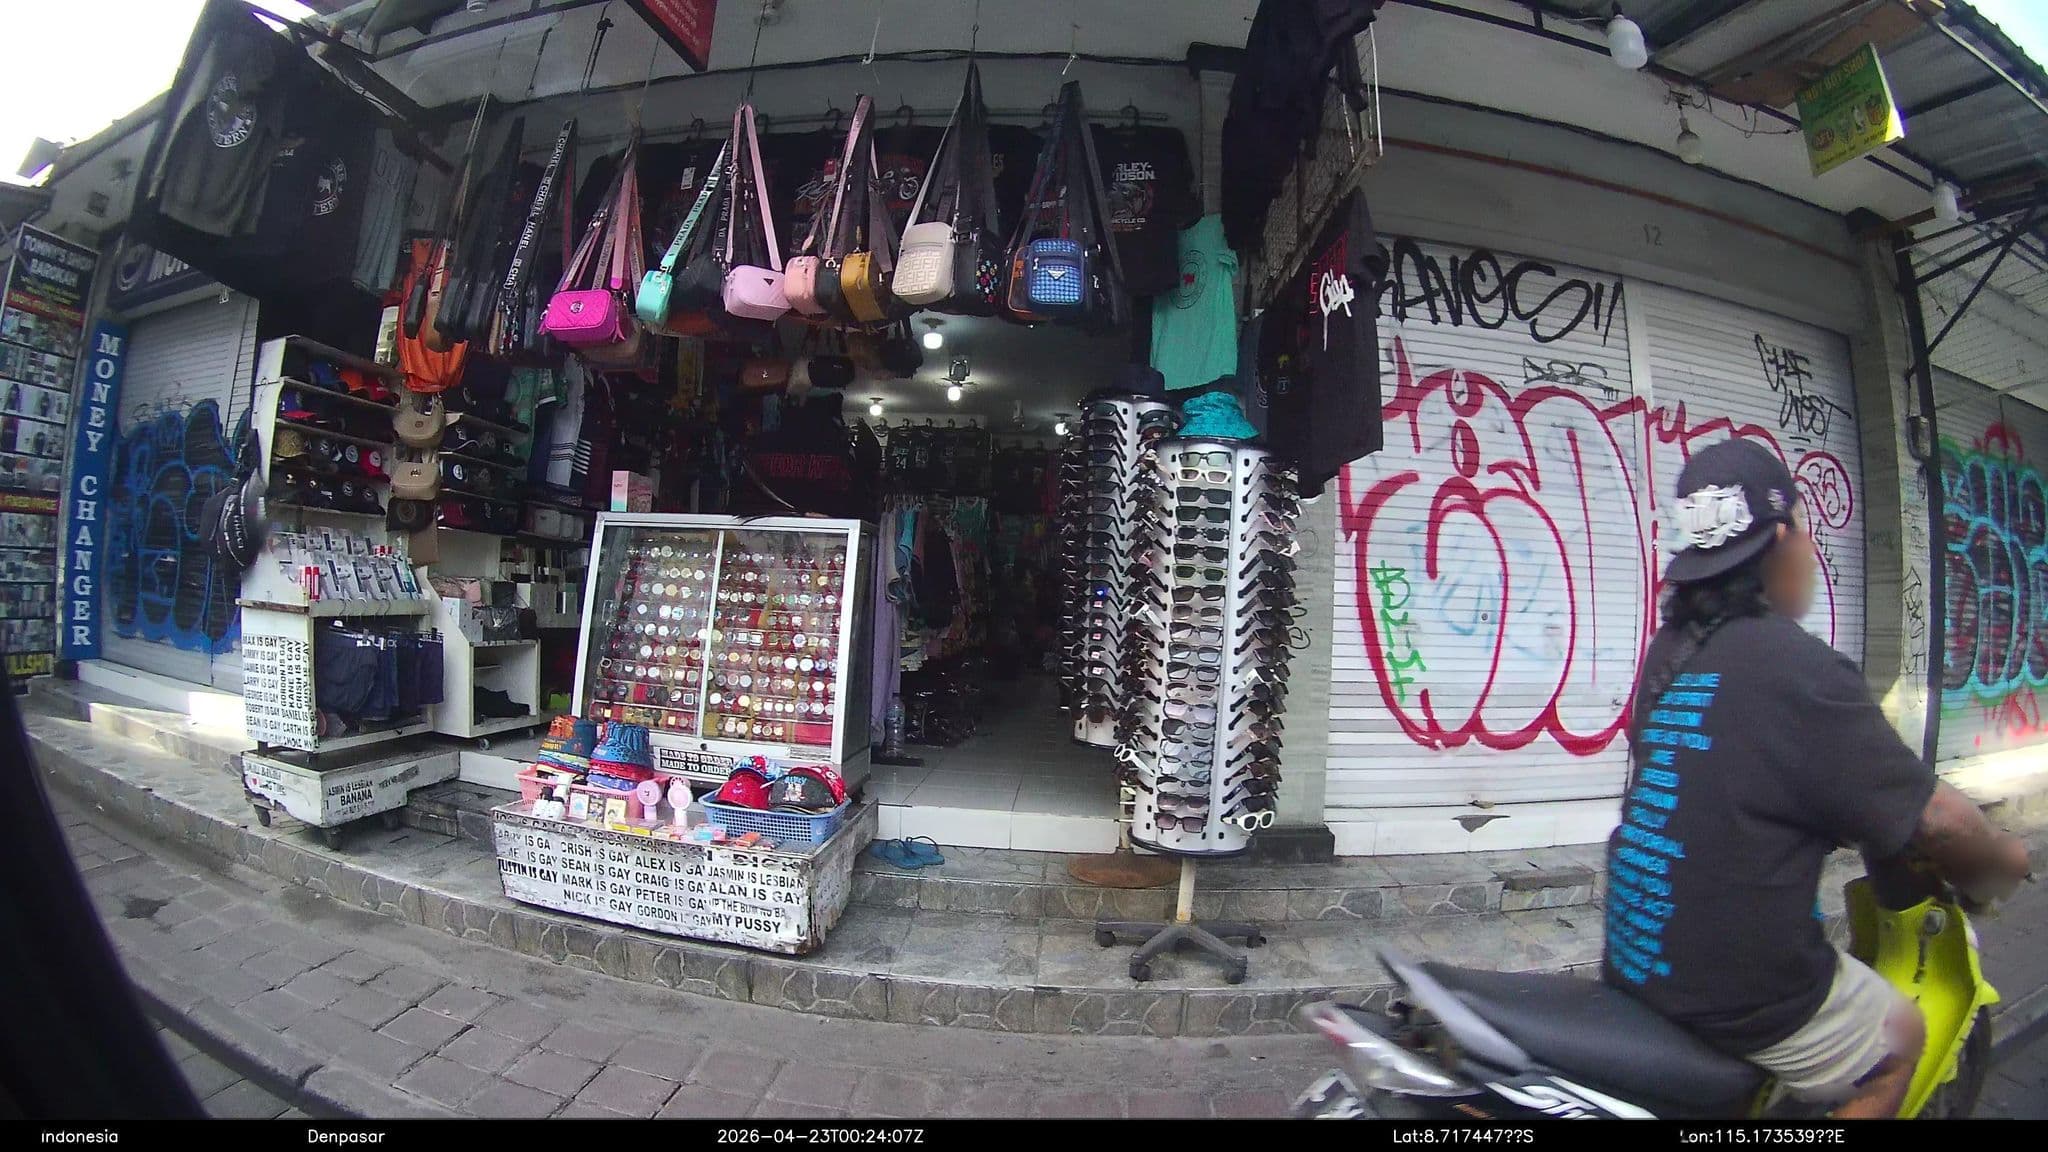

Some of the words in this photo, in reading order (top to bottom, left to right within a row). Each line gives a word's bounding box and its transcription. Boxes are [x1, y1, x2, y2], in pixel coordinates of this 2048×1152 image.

[1116, 161, 1152, 172] RLEY-
[87, 333, 122, 452] MONEY
[73, 475, 97, 646] CHANGER
[265, 637, 277, 647] GAY
[660, 749, 686, 760] MADE
[687, 752, 699, 762] TO
[660, 759, 686, 769] MADE
[687, 762, 700, 772] TO
[701, 763, 731, 774] ORDER
[340, 789, 373, 806] BANANA
[525, 835, 534, 847] IS
[537, 838, 551, 851] GA
[528, 852, 536, 863] IS
[539, 853, 558, 867] GAY
[561, 841, 592, 857] CRISH
[609, 850, 630, 865] GAY
[635, 855, 665, 871] ALEX
[670, 860, 681, 873] IS
[529, 866, 537, 878] IS
[539, 868, 558, 884] GAY
[561, 857, 590, 873] SEAN
[594, 864, 605, 876] IS
[609, 865, 631, 880] GAY
[635, 871, 669, 888] CRAIG
[675, 878, 684, 890] IS
[708, 866, 744, 882] JASMIN
[748, 873, 756, 883] IS
[760, 874, 803, 889] LESBIAN
[562, 874, 593, 890] MARK
[597, 880, 606, 892] IS
[610, 882, 631, 897] GAY
[636, 888, 671, 905] PETER
[675, 894, 683, 907] IS
[709, 882, 747, 898] ALAN
[753, 889, 767, 901] IS
[772, 891, 801, 905] GAY
[563, 889, 593, 904] NICK
[610, 899, 632, 914] GAY
[637, 904, 678, 922] GORDON
[692, 914, 711, 927] GAY
[723, 899, 738, 912] THE
[712, 912, 731, 926] MY
[735, 917, 781, 934] PUSSY
